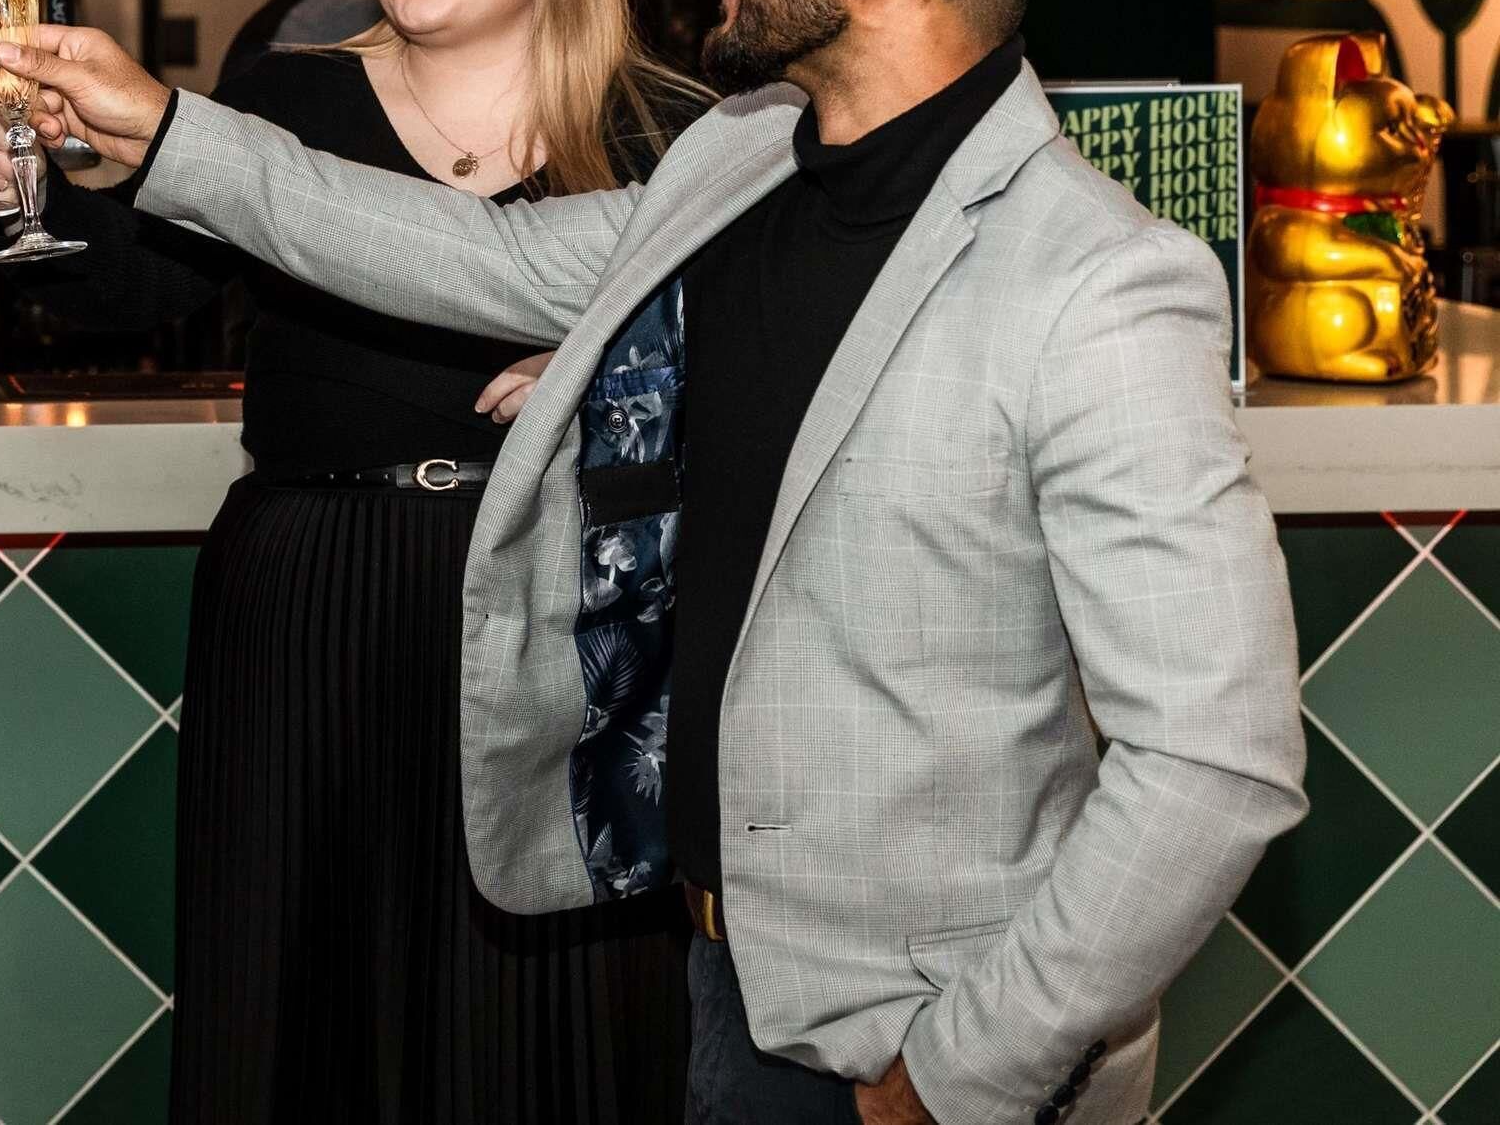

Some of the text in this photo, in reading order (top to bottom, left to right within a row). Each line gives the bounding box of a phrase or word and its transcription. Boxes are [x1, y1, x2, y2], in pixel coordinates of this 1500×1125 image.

[1060, 91, 1236, 135] APPY HOUR
[1068, 116, 1237, 158] PPY HOUR
[1149, 141, 1237, 174] HOUR
[1149, 166, 1237, 199] HOUR
[1150, 191, 1237, 221] HOUR
[1179, 215, 1237, 243] UR
